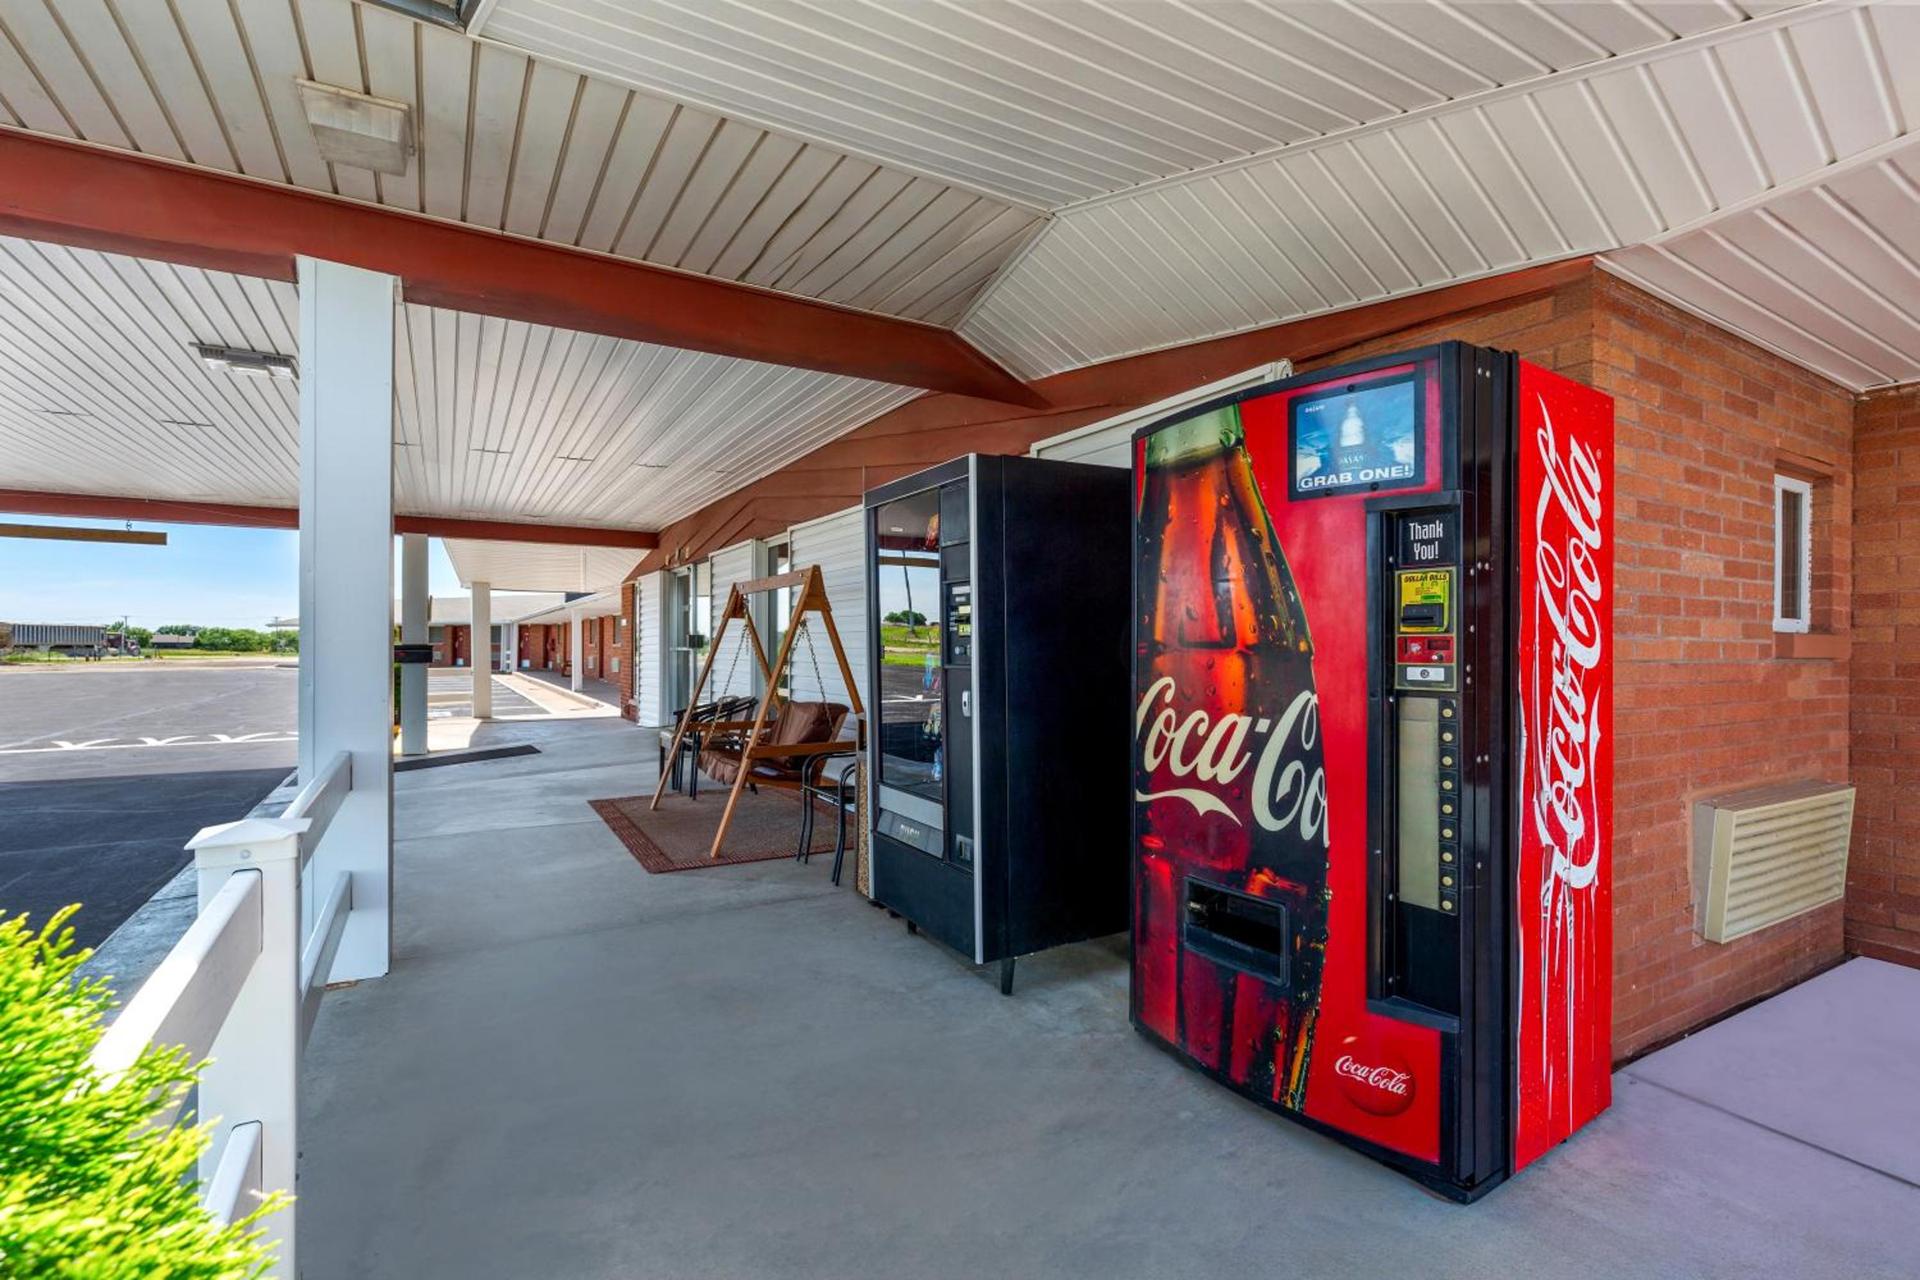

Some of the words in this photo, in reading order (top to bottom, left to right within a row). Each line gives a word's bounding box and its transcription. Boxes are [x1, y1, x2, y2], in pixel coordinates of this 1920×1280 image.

[1300, 471, 1353, 489] GRAB
[1359, 465, 1410, 482] ONE!
[1409, 520, 1443, 541] Thank
[1414, 541, 1439, 560] You!
[1533, 393, 1602, 889] Coca-Cola
[1136, 677, 1330, 848] Coca-Co
[1335, 1055, 1411, 1095] Coca-Cola
